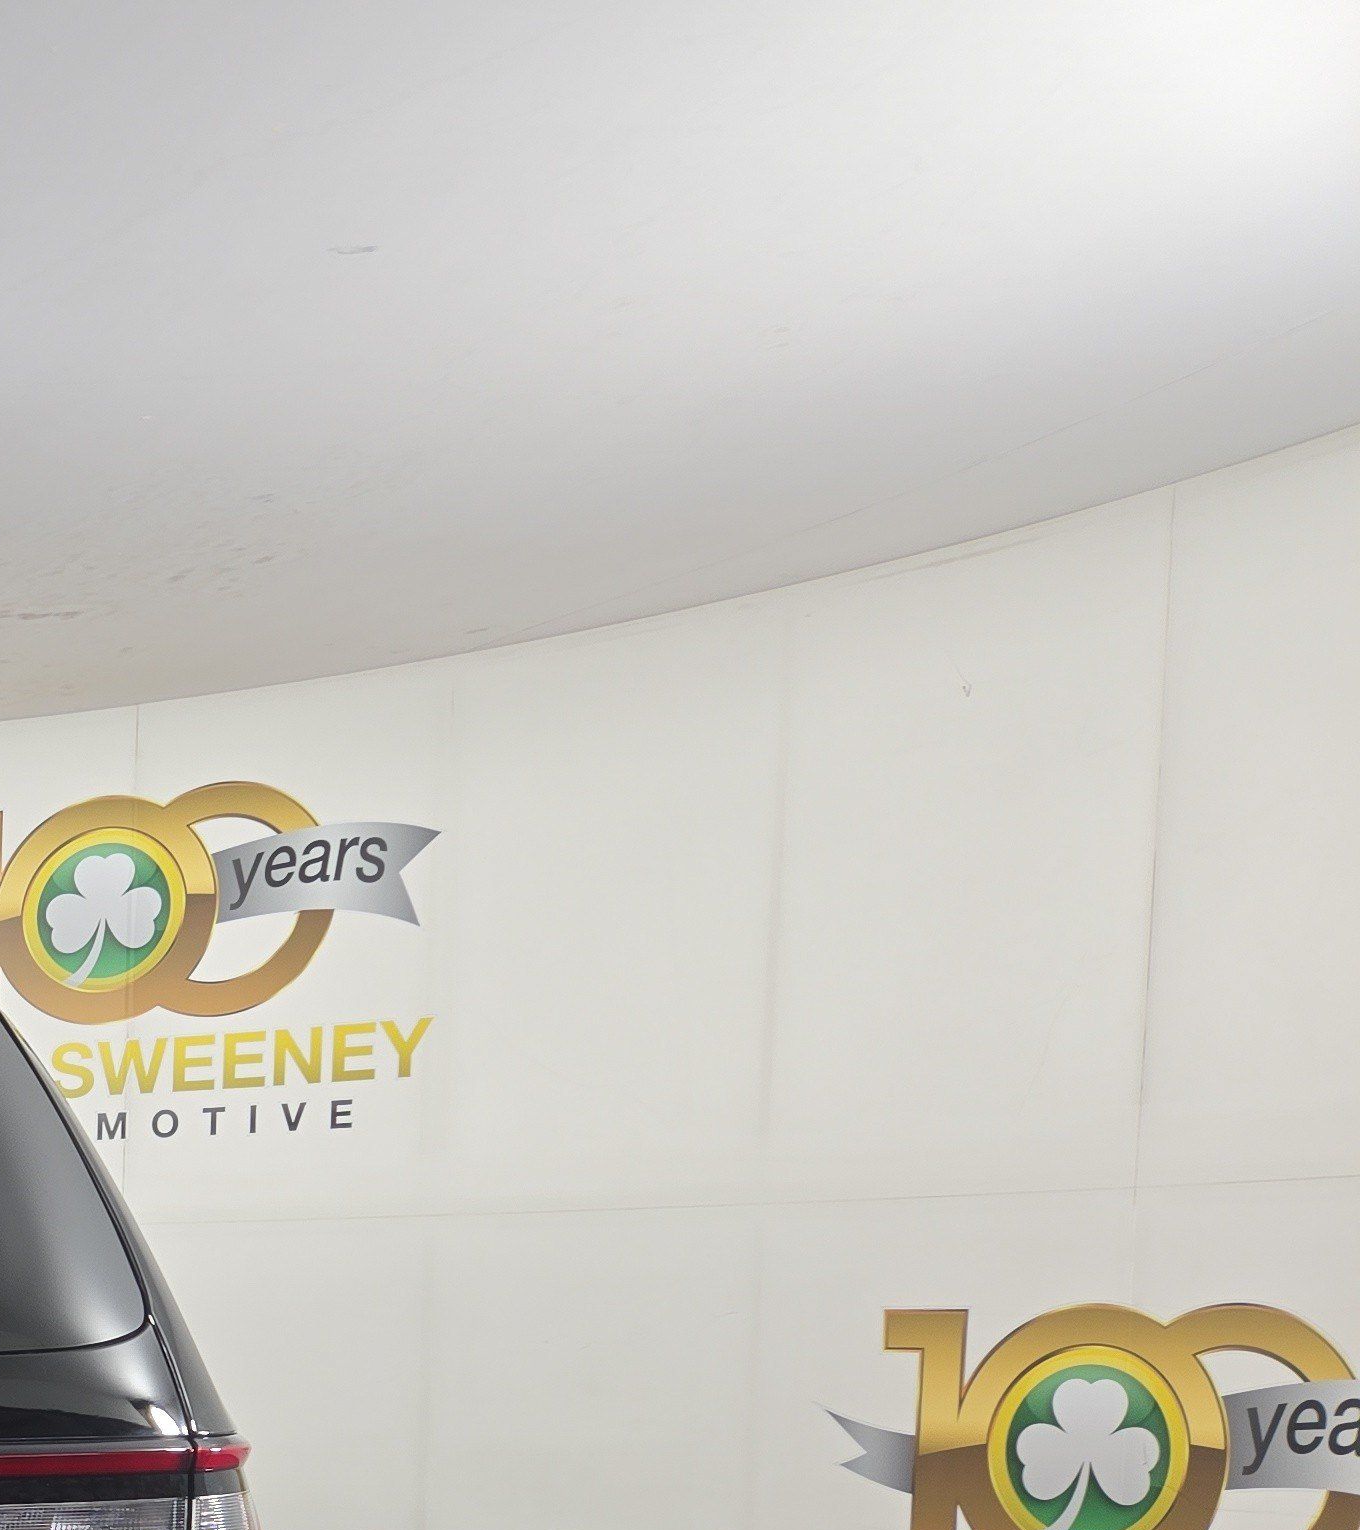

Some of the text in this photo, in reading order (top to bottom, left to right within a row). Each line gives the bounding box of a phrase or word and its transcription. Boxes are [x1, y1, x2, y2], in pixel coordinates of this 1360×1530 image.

[229, 835, 388, 910] years
[52, 1016, 435, 1100] SWEENEY
[96, 1099, 354, 1141] MOTIVE
[1242, 1398, 1360, 1476] yea
